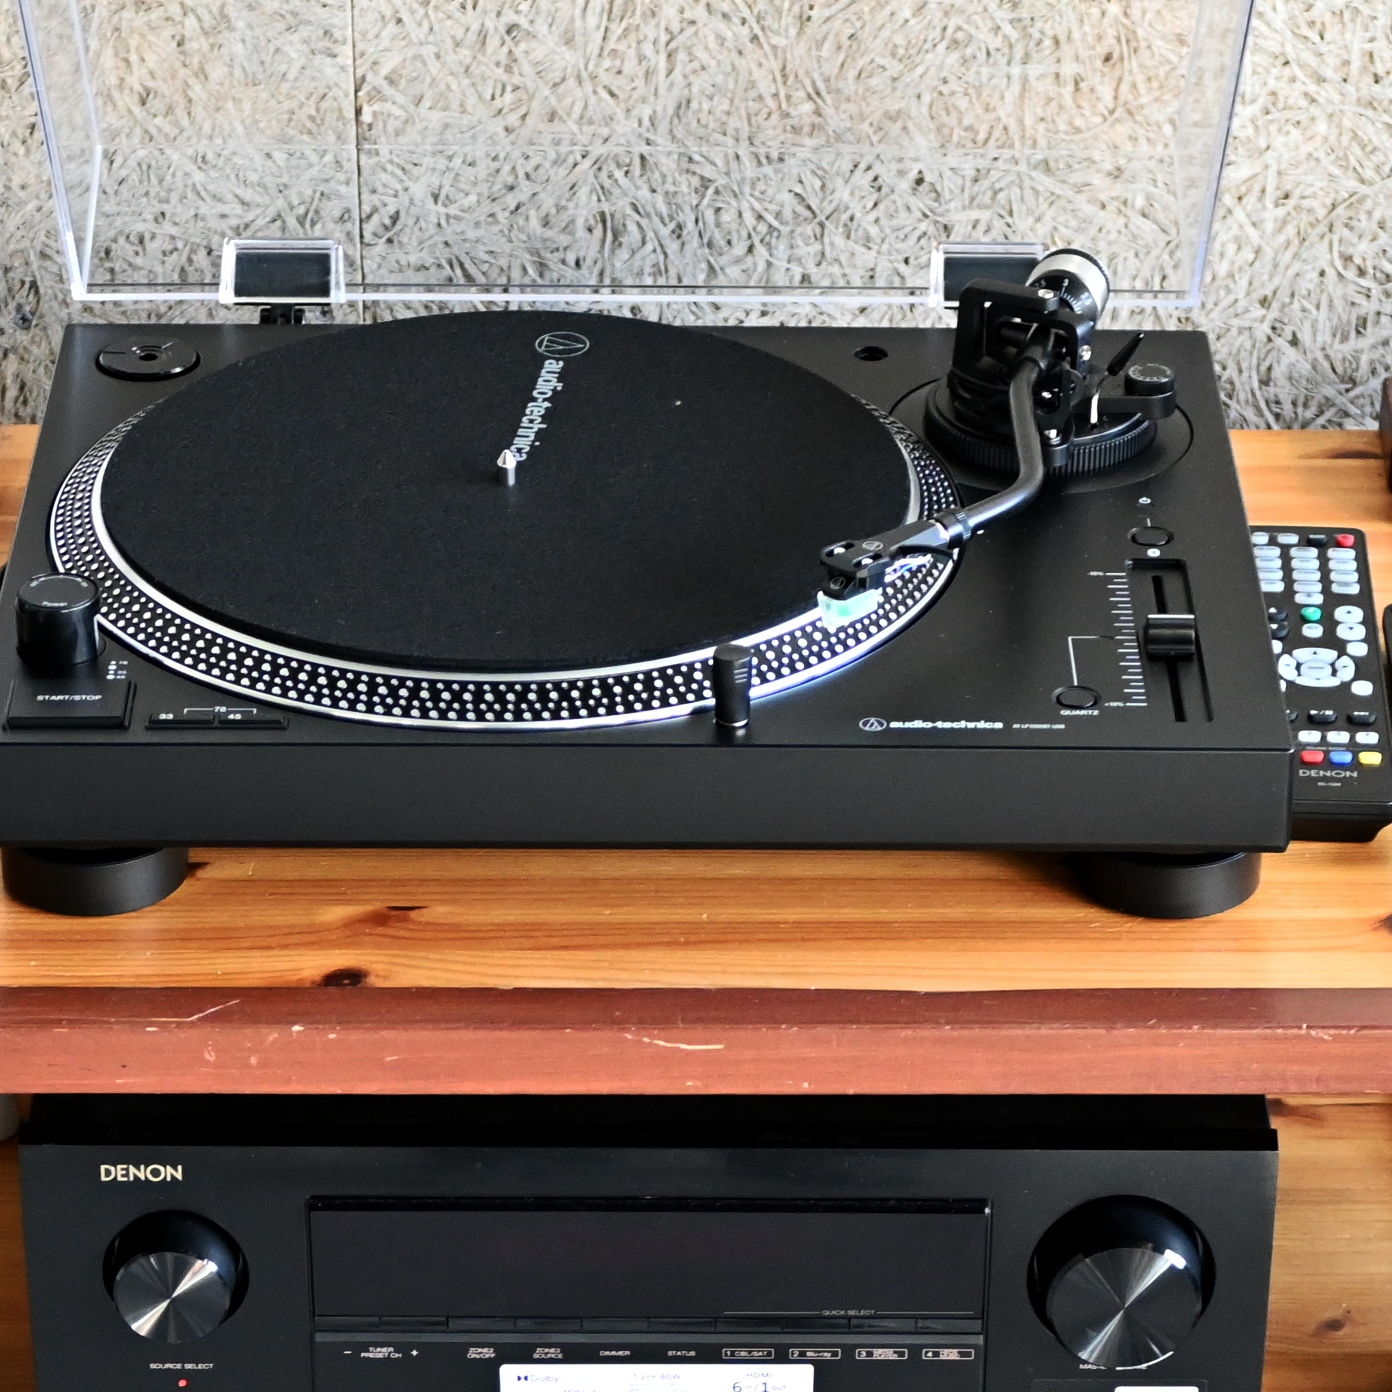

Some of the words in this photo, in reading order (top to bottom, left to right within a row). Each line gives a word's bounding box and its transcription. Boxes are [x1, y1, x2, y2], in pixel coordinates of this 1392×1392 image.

[509, 359, 565, 462] audio-technica
[889, 720, 1004, 729] audio-technica
[1298, 769, 1358, 779] DENON
[99, 1163, 183, 1182] DENON
[530, 1374, 559, 1383] Dolby
[732, 1382, 742, 1392] 6
